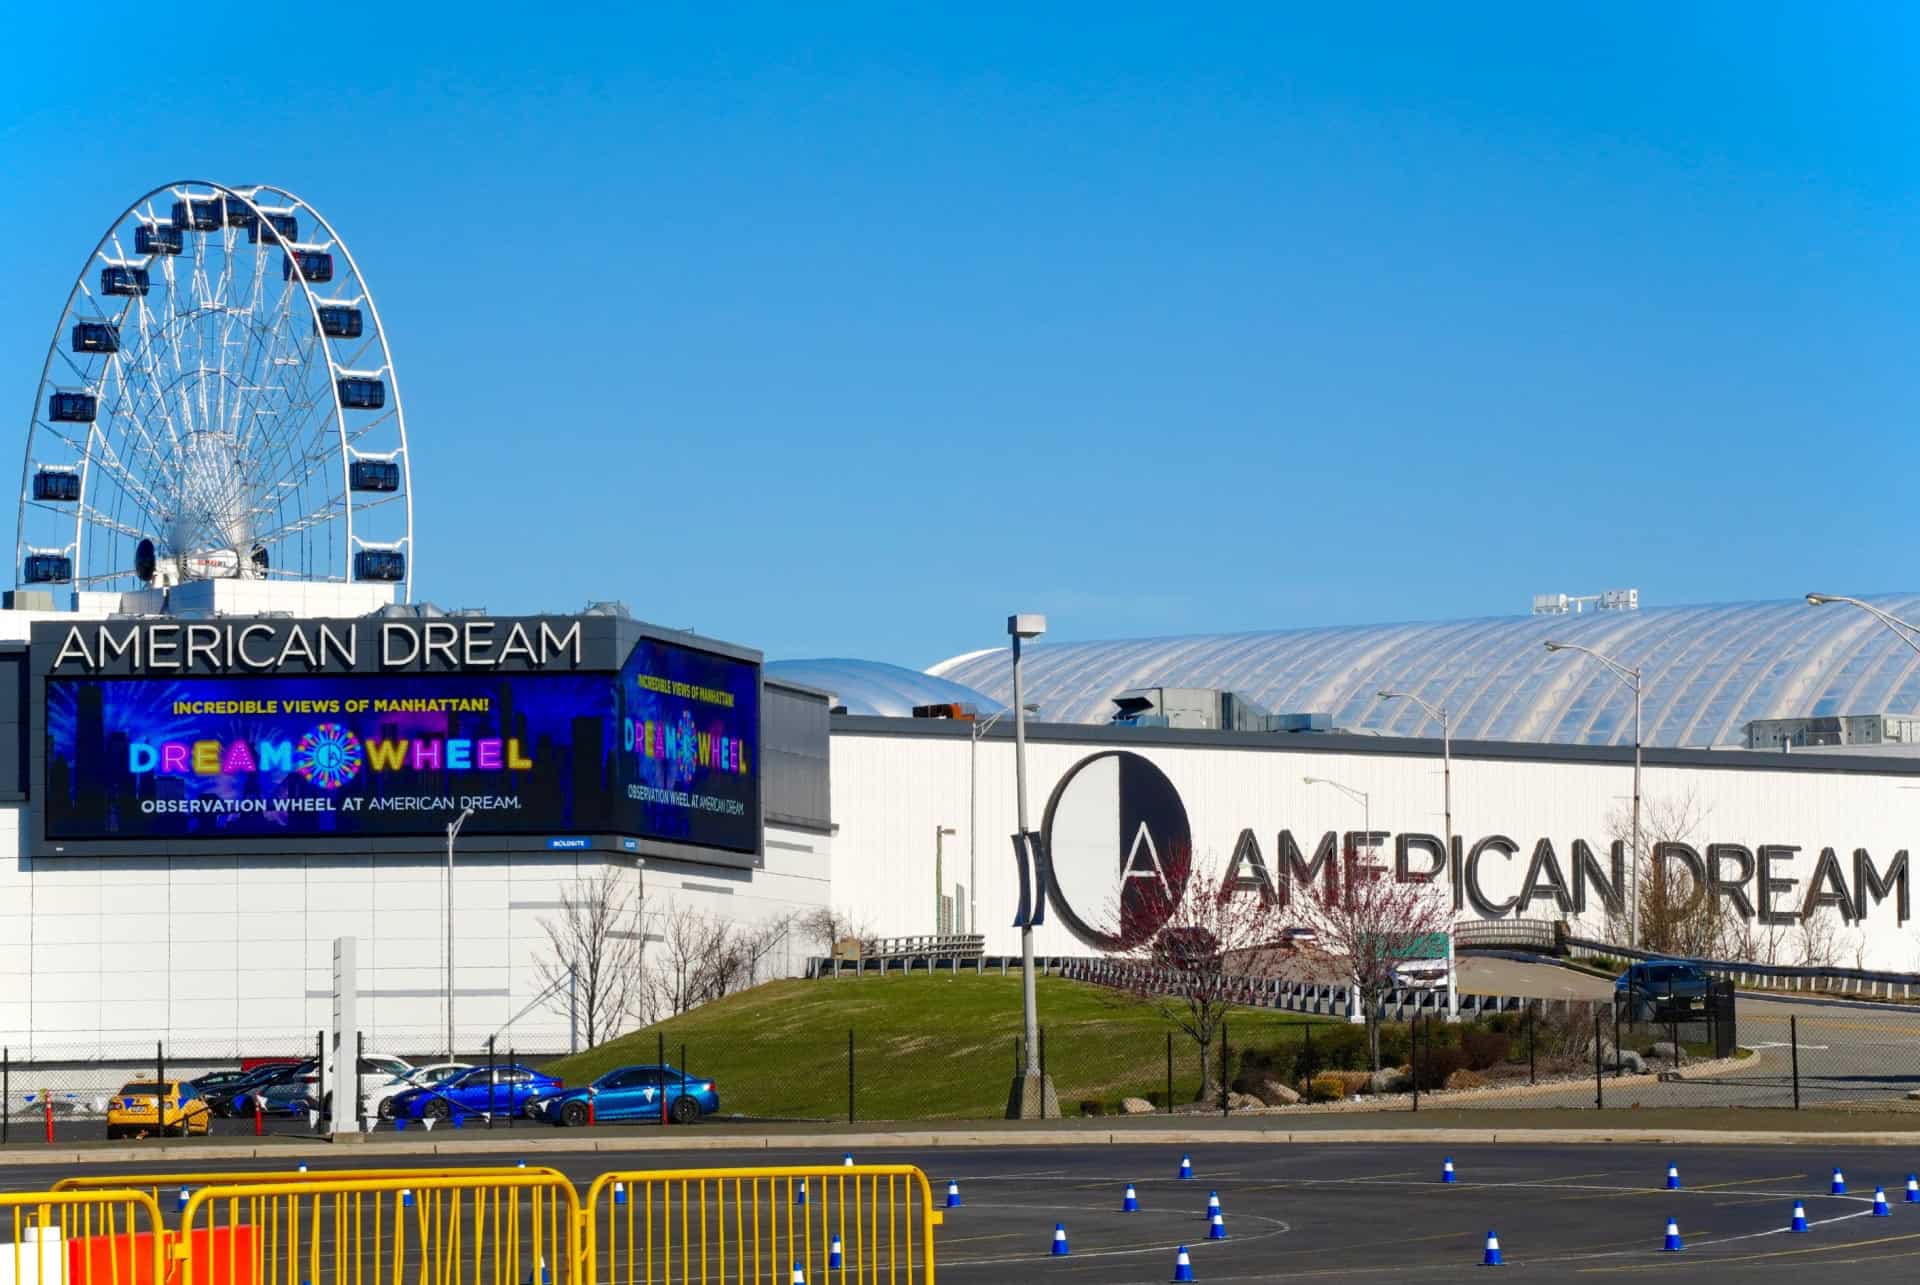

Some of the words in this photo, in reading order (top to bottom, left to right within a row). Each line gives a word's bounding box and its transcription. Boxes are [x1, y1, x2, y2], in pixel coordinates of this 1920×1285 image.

[53, 622, 357, 669] AMERICAN
[383, 620, 582, 667] DREAM
[638, 673, 671, 695] INCREDIBLE
[672, 680, 690, 698] VIEWS
[691, 684, 700, 701] OF
[173, 701, 278, 715] INCREDIBLE
[282, 700, 340, 713] VIEWS
[344, 700, 369, 713] OF
[373, 698, 490, 713] MANHATTAN!
[128, 739, 293, 774] DREAM
[365, 738, 533, 771] WHEEL
[624, 717, 677, 761] DREAM
[697, 730, 748, 775] WHEEL
[141, 799, 267, 814] OBSERVATION
[272, 798, 337, 812] WHEEL
[342, 797, 364, 812] AT
[368, 796, 455, 811] AMERICAN
[627, 783, 669, 804] OBSERVATION
[670, 790, 691, 808] WHEEL
[691, 795, 700, 809] AT
[1120, 820, 1175, 904] A
[1216, 827, 1625, 919] AMERICAN
[1651, 841, 1911, 927] DREAM
